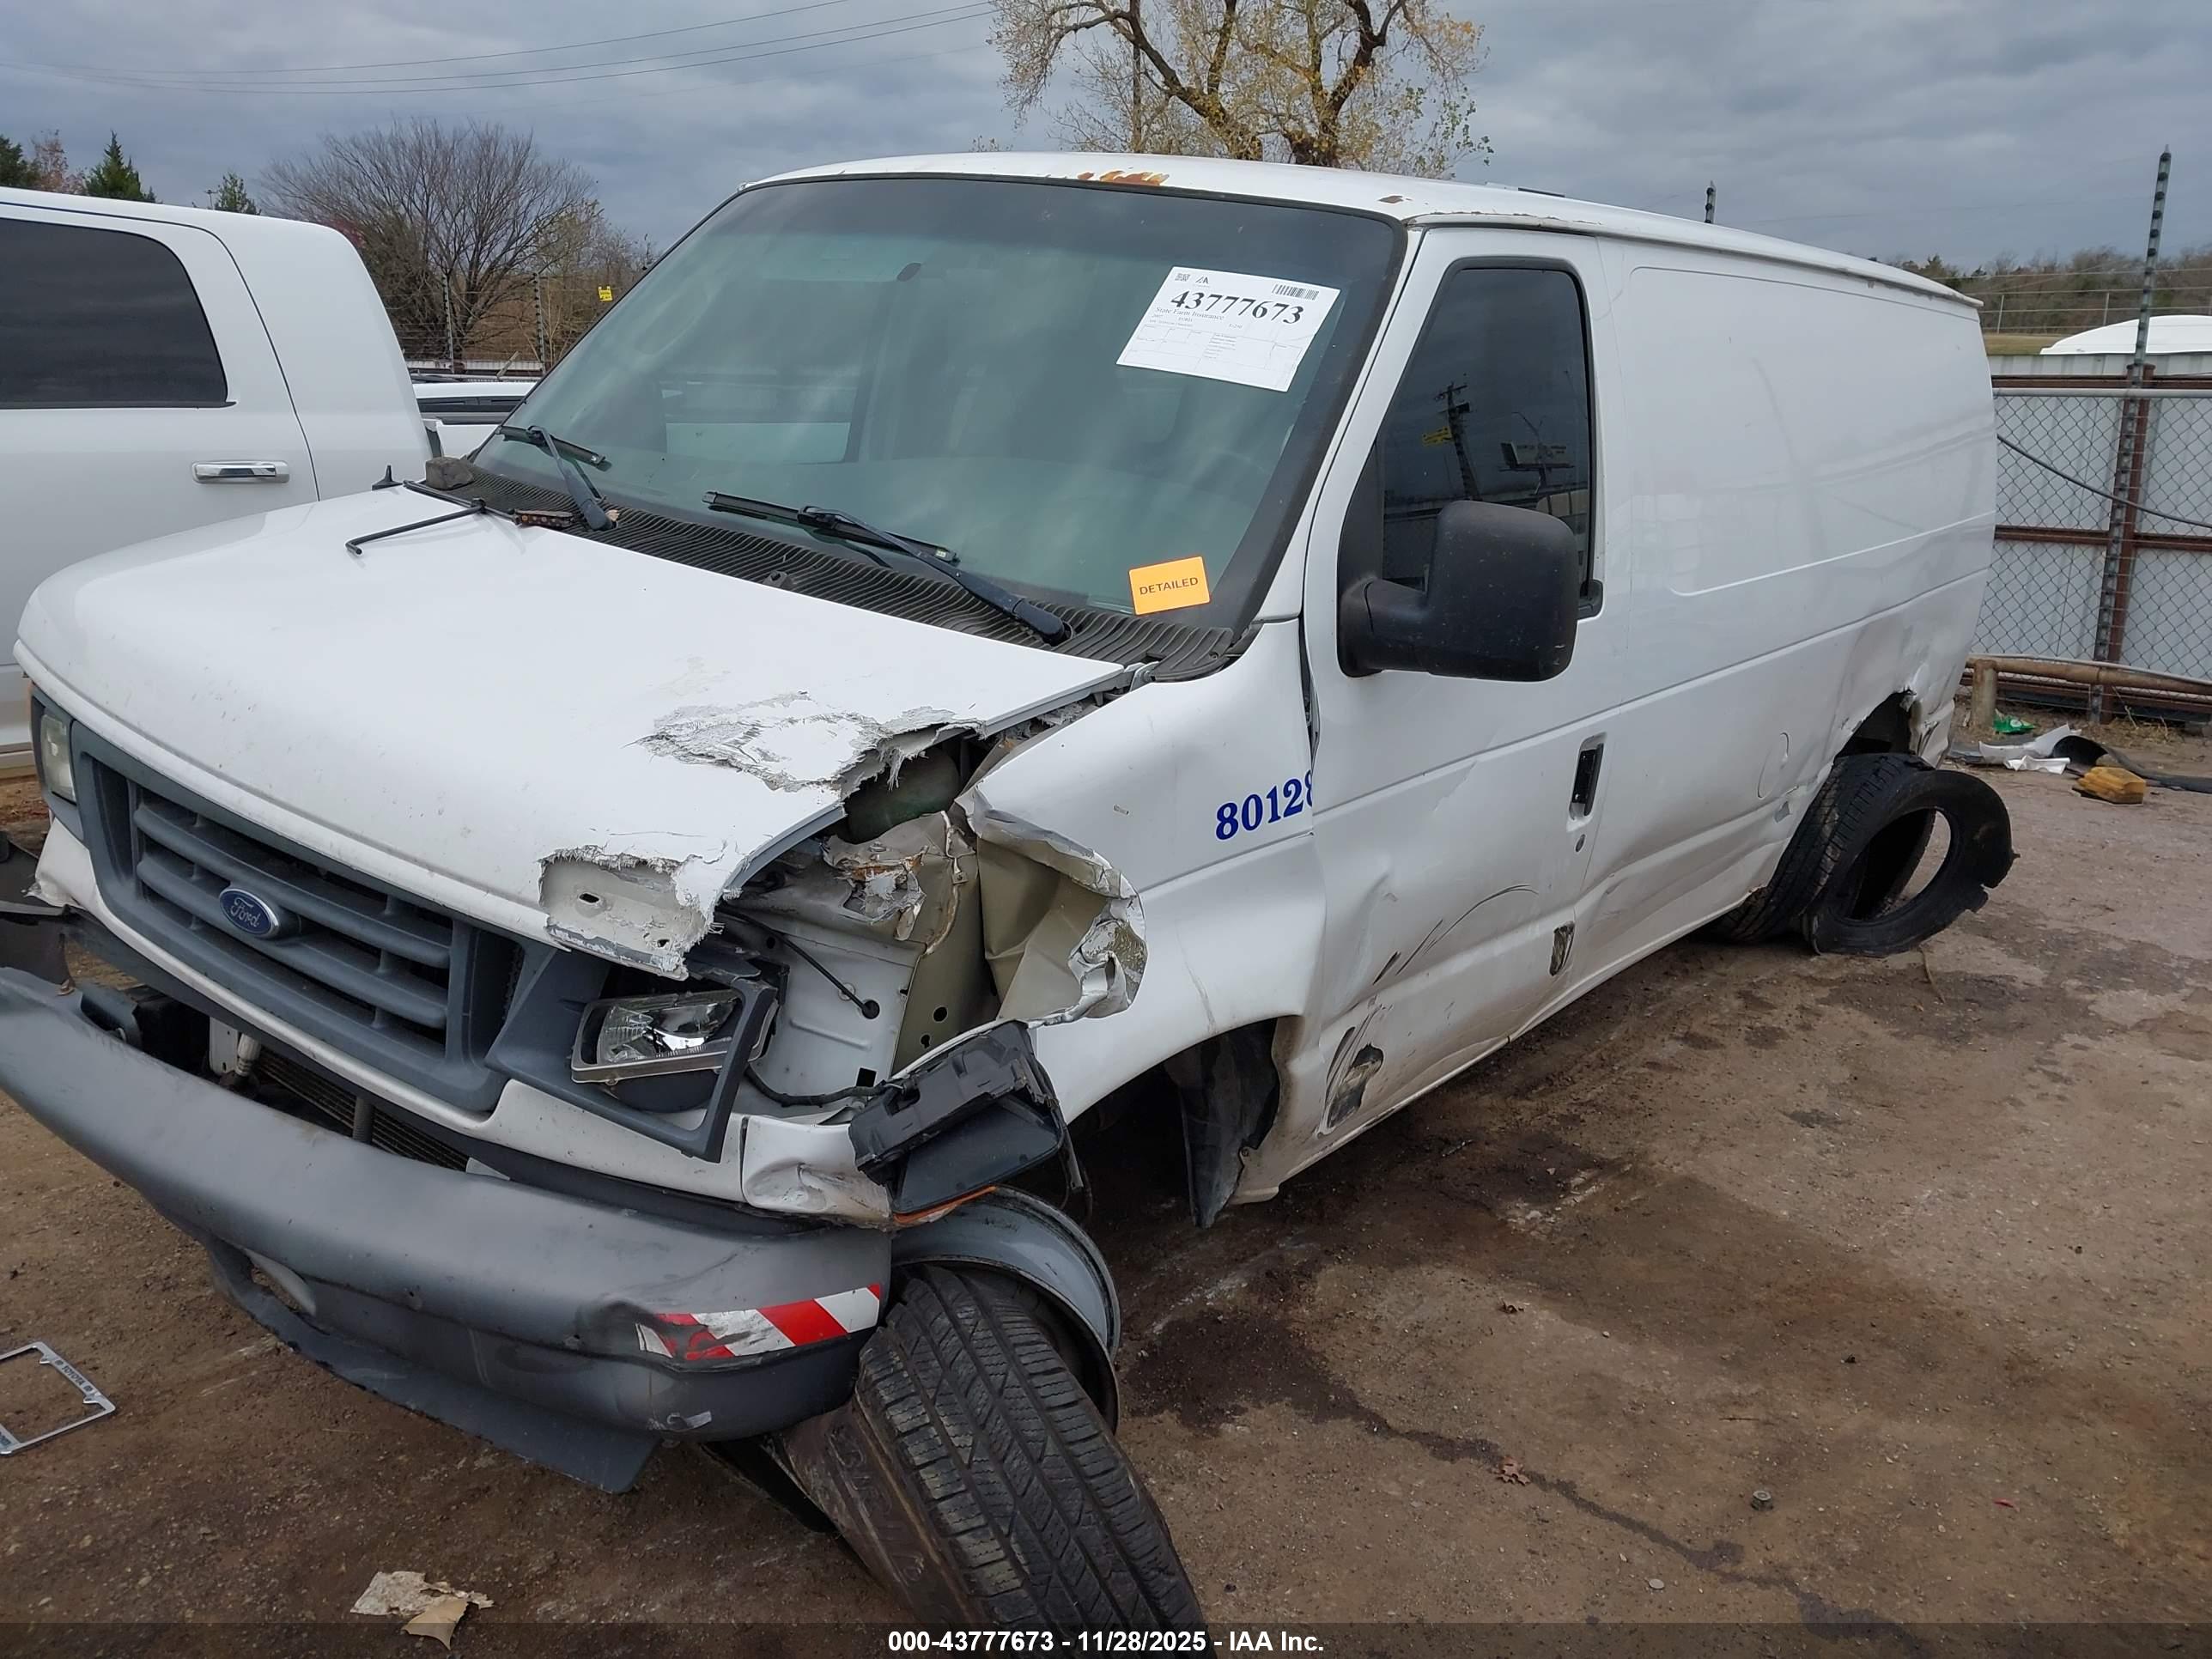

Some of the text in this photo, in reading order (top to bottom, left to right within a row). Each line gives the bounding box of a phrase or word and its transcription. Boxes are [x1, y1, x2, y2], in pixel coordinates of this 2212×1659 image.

[1170, 290, 1305, 325] 43777673
[1192, 311, 1224, 320] Insurance
[1139, 577, 1199, 595] DETAILED
[230, 897, 260, 927] Ford
